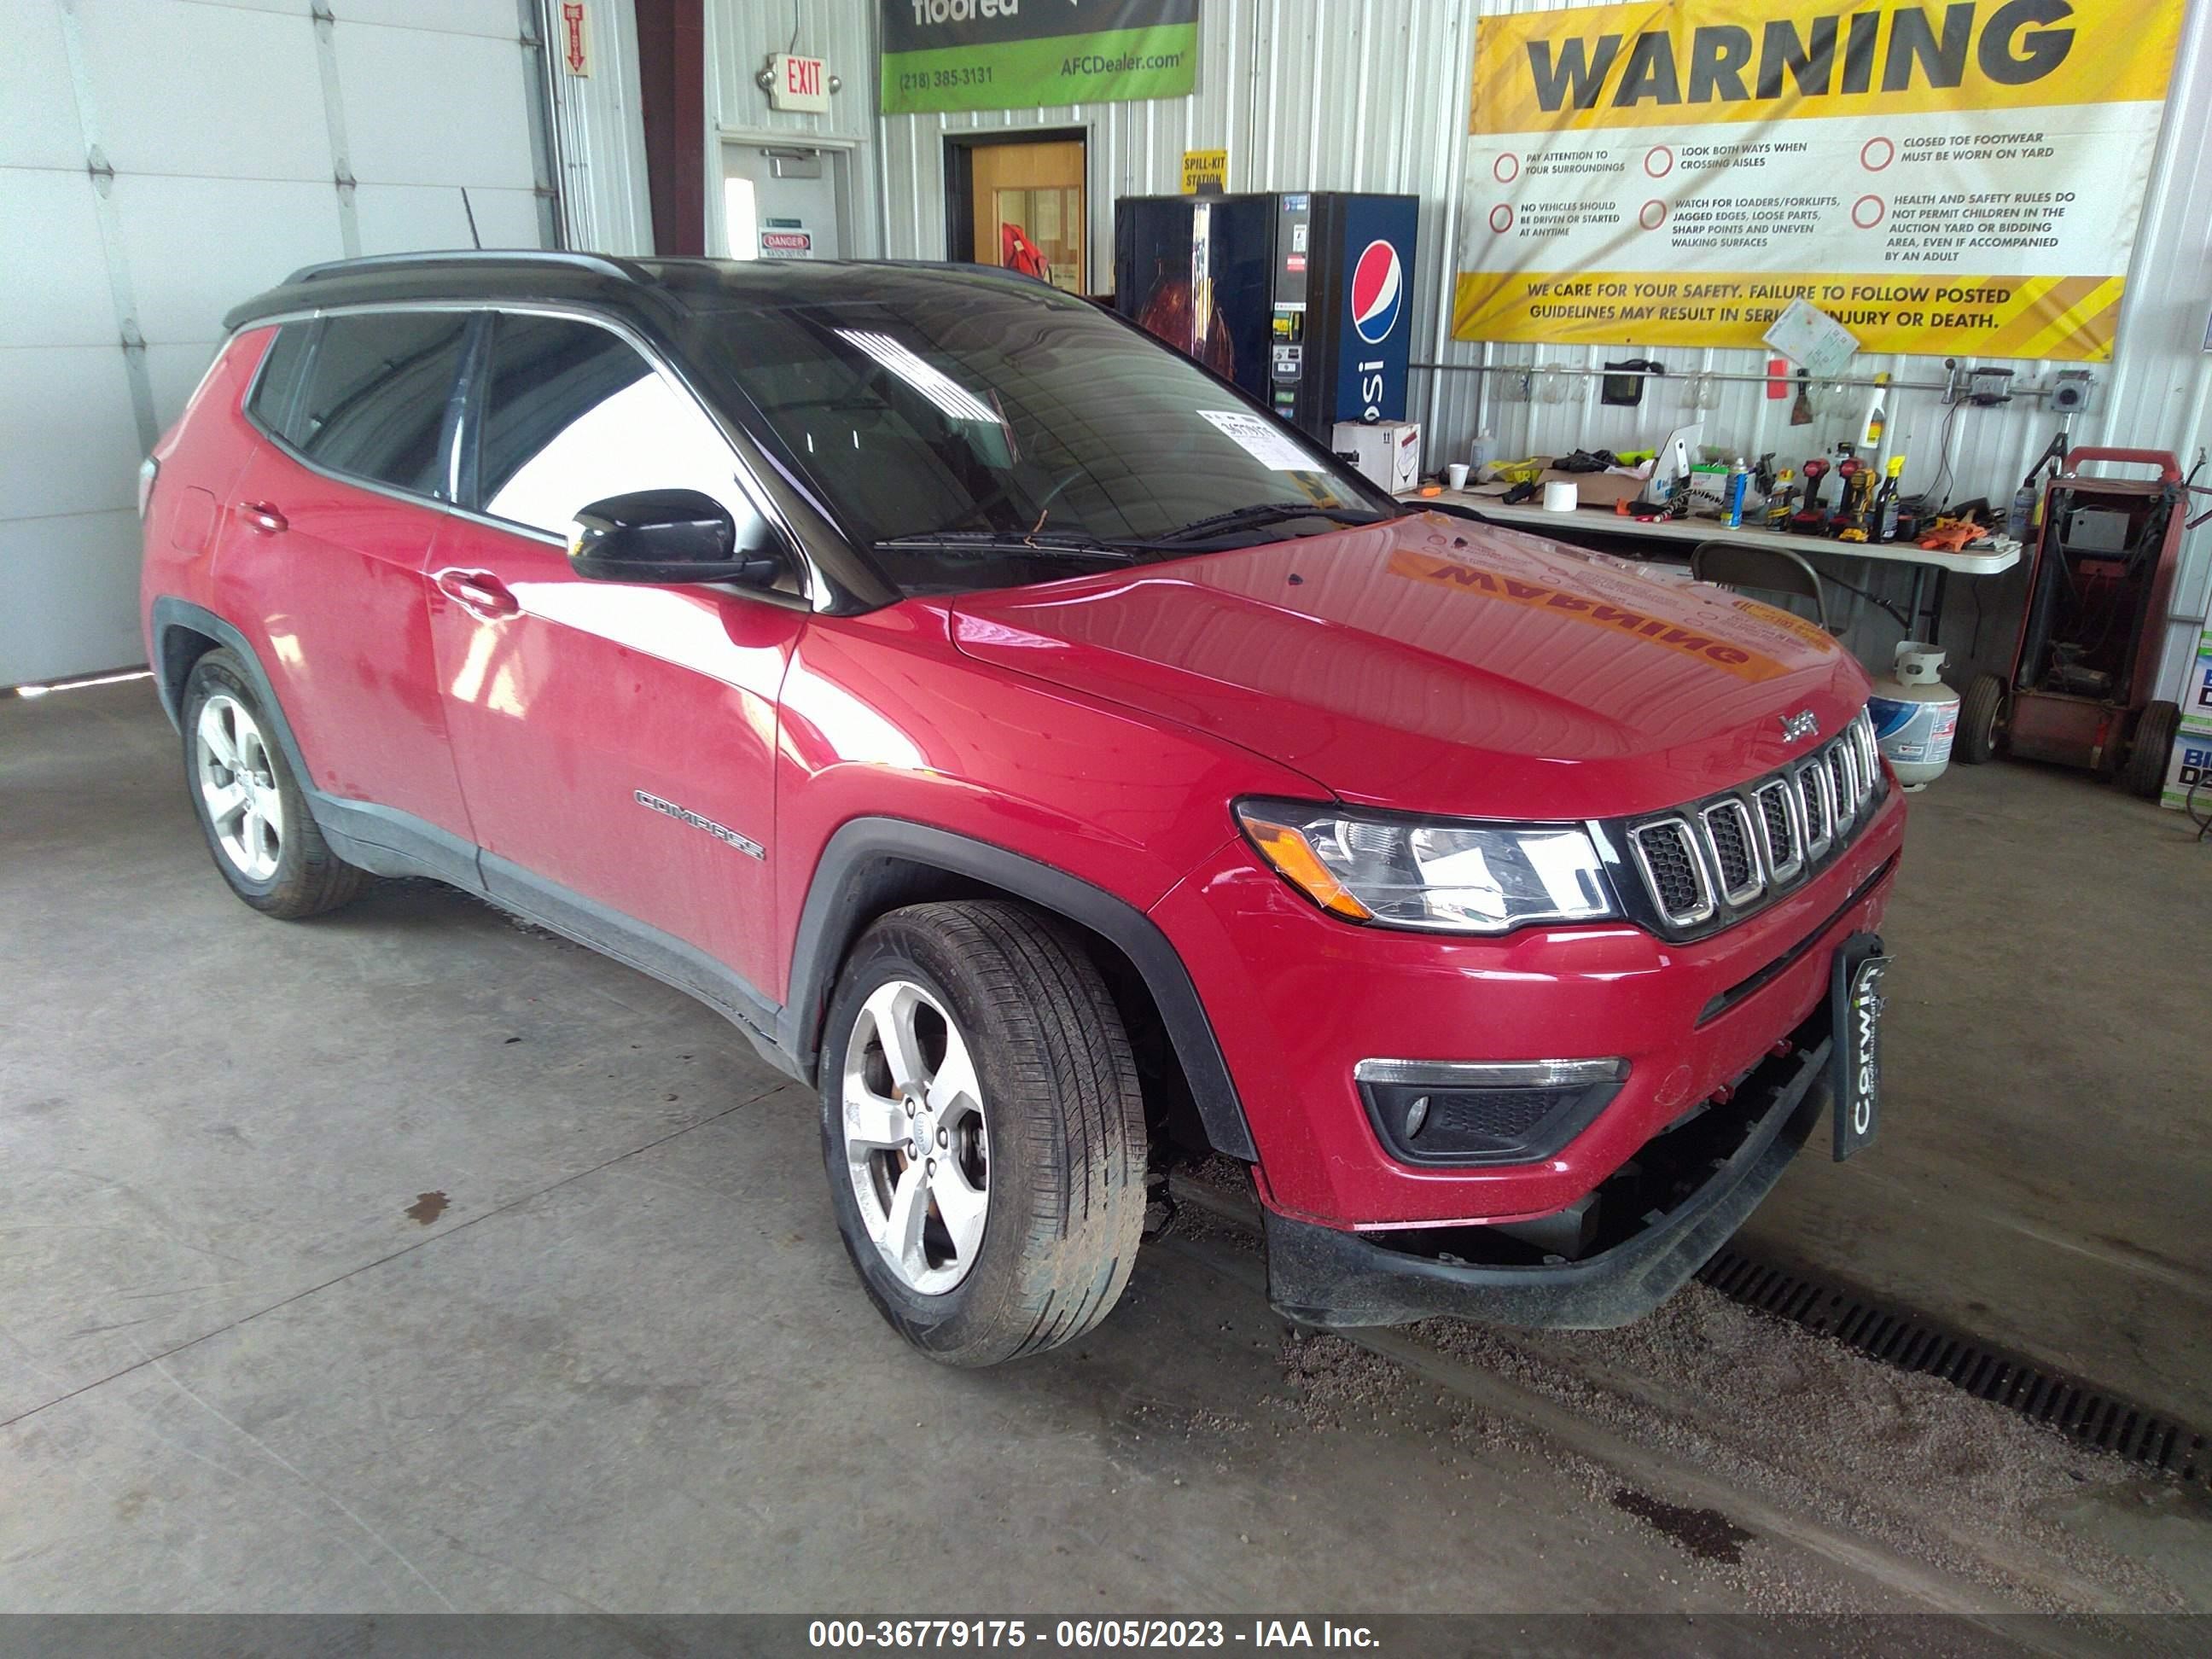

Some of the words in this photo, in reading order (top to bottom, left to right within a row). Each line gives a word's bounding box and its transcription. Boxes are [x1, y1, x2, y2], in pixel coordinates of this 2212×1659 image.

[1527, 0, 2076, 111] WARNING
[1061, 53, 1180, 77] AFCDealer.com
[788, 59, 821, 96] EXIT
[899, 68, 930, 91] (218)
[934, 67, 992, 87] 385-3131
[1904, 137, 1946, 148] CLOSED
[1949, 136, 1970, 145] TOE
[1974, 133, 2043, 144] FOOTWEAR
[1681, 147, 1709, 156] LOOK
[1713, 145, 1739, 155] BOTH
[1742, 144, 1771, 154] WAYS
[1774, 143, 1807, 152] WHEN
[1901, 152, 1932, 162] MUST
[1936, 152, 1949, 160] BE
[1953, 149, 1991, 160] WORN
[1996, 148, 2017, 159] ON
[2021, 148, 2054, 157] YARD
[1527, 154, 1542, 162] PAY
[1544, 152, 1592, 161] ATTENTION
[1596, 150, 1608, 160] TO
[1185, 156, 1225, 171] SPILL-KIT
[1525, 166, 1548, 175] YOUR
[1551, 163, 1626, 174] SURROUNDINGS
[1680, 160, 1730, 170] CROSSING
[1732, 158, 1766, 167] AISLES
[1187, 173, 1221, 186] STATION
[1675, 199, 1708, 208] WATCH
[1713, 198, 1732, 208] FOR
[1735, 196, 1841, 207] LOADERS/FORKLIFTS,
[1894, 195, 1936, 205] HEALTH
[1939, 195, 1965, 204] AND
[1969, 193, 2011, 204] SAFETY
[2014, 193, 2052, 203] RULES
[2055, 192, 2075, 202] DO
[1521, 204, 1536, 212] NO
[1540, 202, 1577, 212] VEHICLES
[1580, 201, 1615, 211] SHOULD
[1520, 216, 1531, 224] BE
[1533, 215, 1565, 224] DRIVEN
[1567, 214, 1580, 224] OR
[1582, 213, 1620, 224] STARTED
[1673, 212, 1713, 222] JAGGED
[1715, 212, 1749, 222] EDGES,
[1752, 211, 1784, 221] LOOSE
[1787, 210, 1821, 221] PARTS,
[1891, 209, 1917, 219] NOT
[1919, 209, 1959, 218] PERMIT
[1962, 208, 2020, 218] CHILDREN
[2023, 207, 2038, 218] IN
[2042, 207, 2065, 218] THE
[1519, 229, 1530, 237] AT
[1533, 228, 1570, 236] ANYTIME
[1672, 224, 1705, 235] SHARP
[1708, 224, 1743, 234] POINTS
[1746, 224, 1769, 234] AND
[1772, 224, 1814, 233] UNEVEN
[1889, 224, 1940, 233] AUCTION
[1944, 223, 1974, 233] YARD
[1977, 223, 1995, 233] OR
[1999, 222, 2052, 233] BIDDING
[768, 236, 804, 247] DANGER
[1672, 237, 1717, 247] WALKING
[1720, 237, 1768, 247] SURFACES
[1887, 237, 1919, 248] AREA,
[1923, 237, 1953, 247] EVEN
[1955, 237, 1965, 247] IF
[1969, 237, 2058, 247] ACCOMPANIED
[1884, 252, 1899, 261] BY
[1902, 252, 1920, 261] AN
[1923, 252, 1959, 261] ADULT
[1528, 282, 1549, 296] WE
[1554, 283, 1592, 296] CARE
[1598, 283, 1627, 297] FOR
[1633, 283, 1677, 298] YOUR
[1683, 284, 1743, 299] SAFETY.
[1749, 284, 1815, 300] FAILURE
[1822, 286, 1844, 300] TO
[1851, 286, 1930, 302] FOLLOW
[1936, 288, 2011, 304] POSTED
[1530, 306, 1615, 318] GUIDELINES
[1620, 306, 1656, 320] MAY
[1659, 307, 1715, 321] RESULT
[1720, 307, 1739, 322] IN
[1744, 308, 1783, 323] SERI
[1896, 312, 1923, 327] OR
[1930, 313, 1999, 329] DEATH.
[634, 789, 766, 861] COMPASS
[1854, 965, 1884, 1135] Corwin
